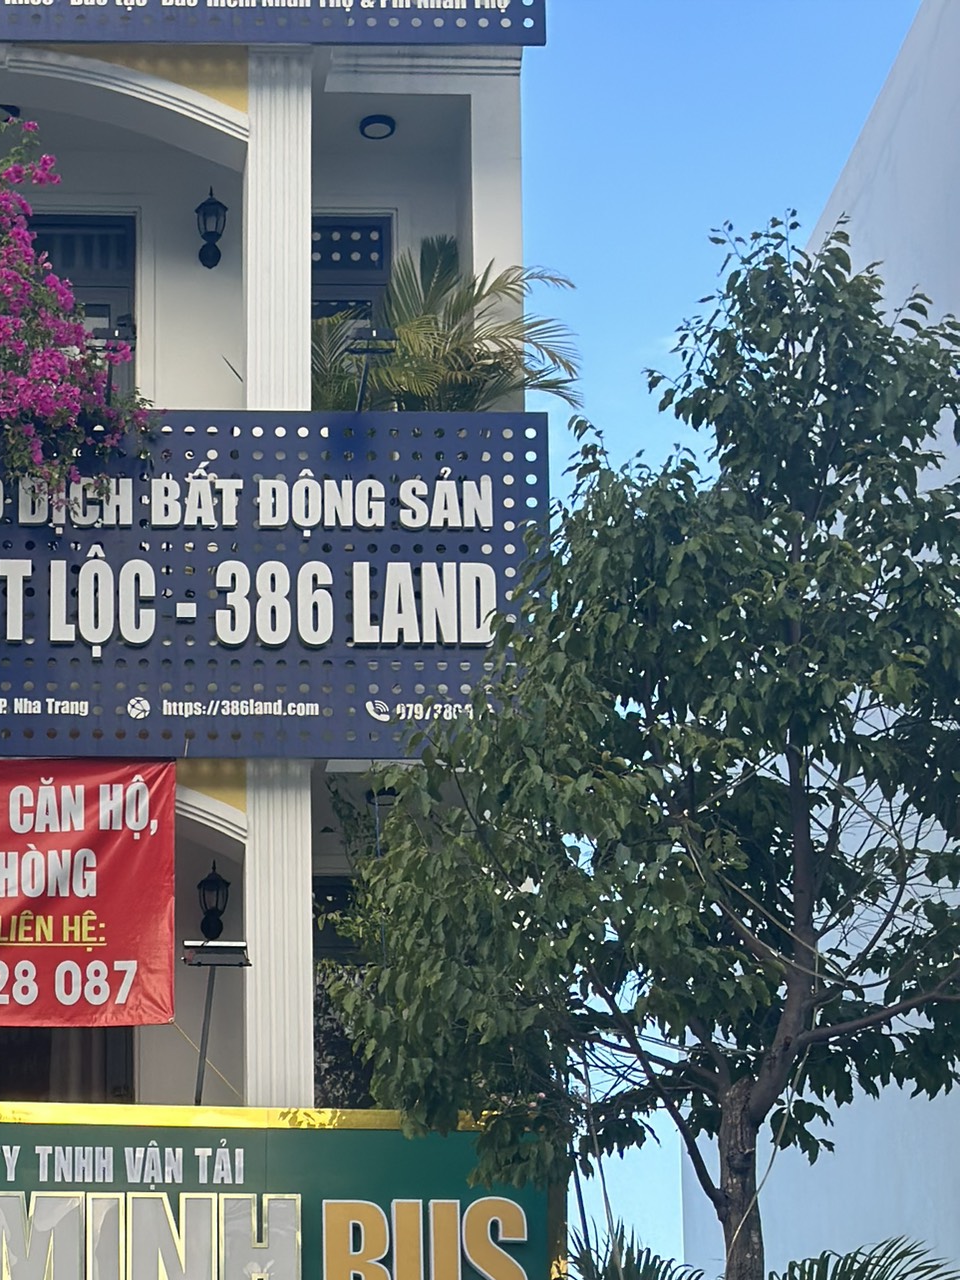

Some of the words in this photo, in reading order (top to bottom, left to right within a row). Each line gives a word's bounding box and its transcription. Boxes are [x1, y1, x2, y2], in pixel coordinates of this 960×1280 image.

[151, 461, 243, 527] BẤT
[257, 468, 385, 538] ĐỘNG
[399, 466, 493, 528] SẢN
[49, 544, 156, 658] LỘC
[215, 560, 334, 646] 386
[352, 561, 497, 645] LAND
[14, 699, 41, 714] Nha
[45, 699, 89, 716] Trang
[163, 699, 319, 717] https://386land.com
[9, 777, 84, 833] CĂN
[98, 774, 159, 840] HỘ,
[62, 909, 106, 952] HỆ:
[54, 960, 138, 1005] 087
[35, 1146, 114, 1183] TNHH
[125, 1140, 183, 1190] VẬN
[194, 1138, 244, 1185] TẢI
